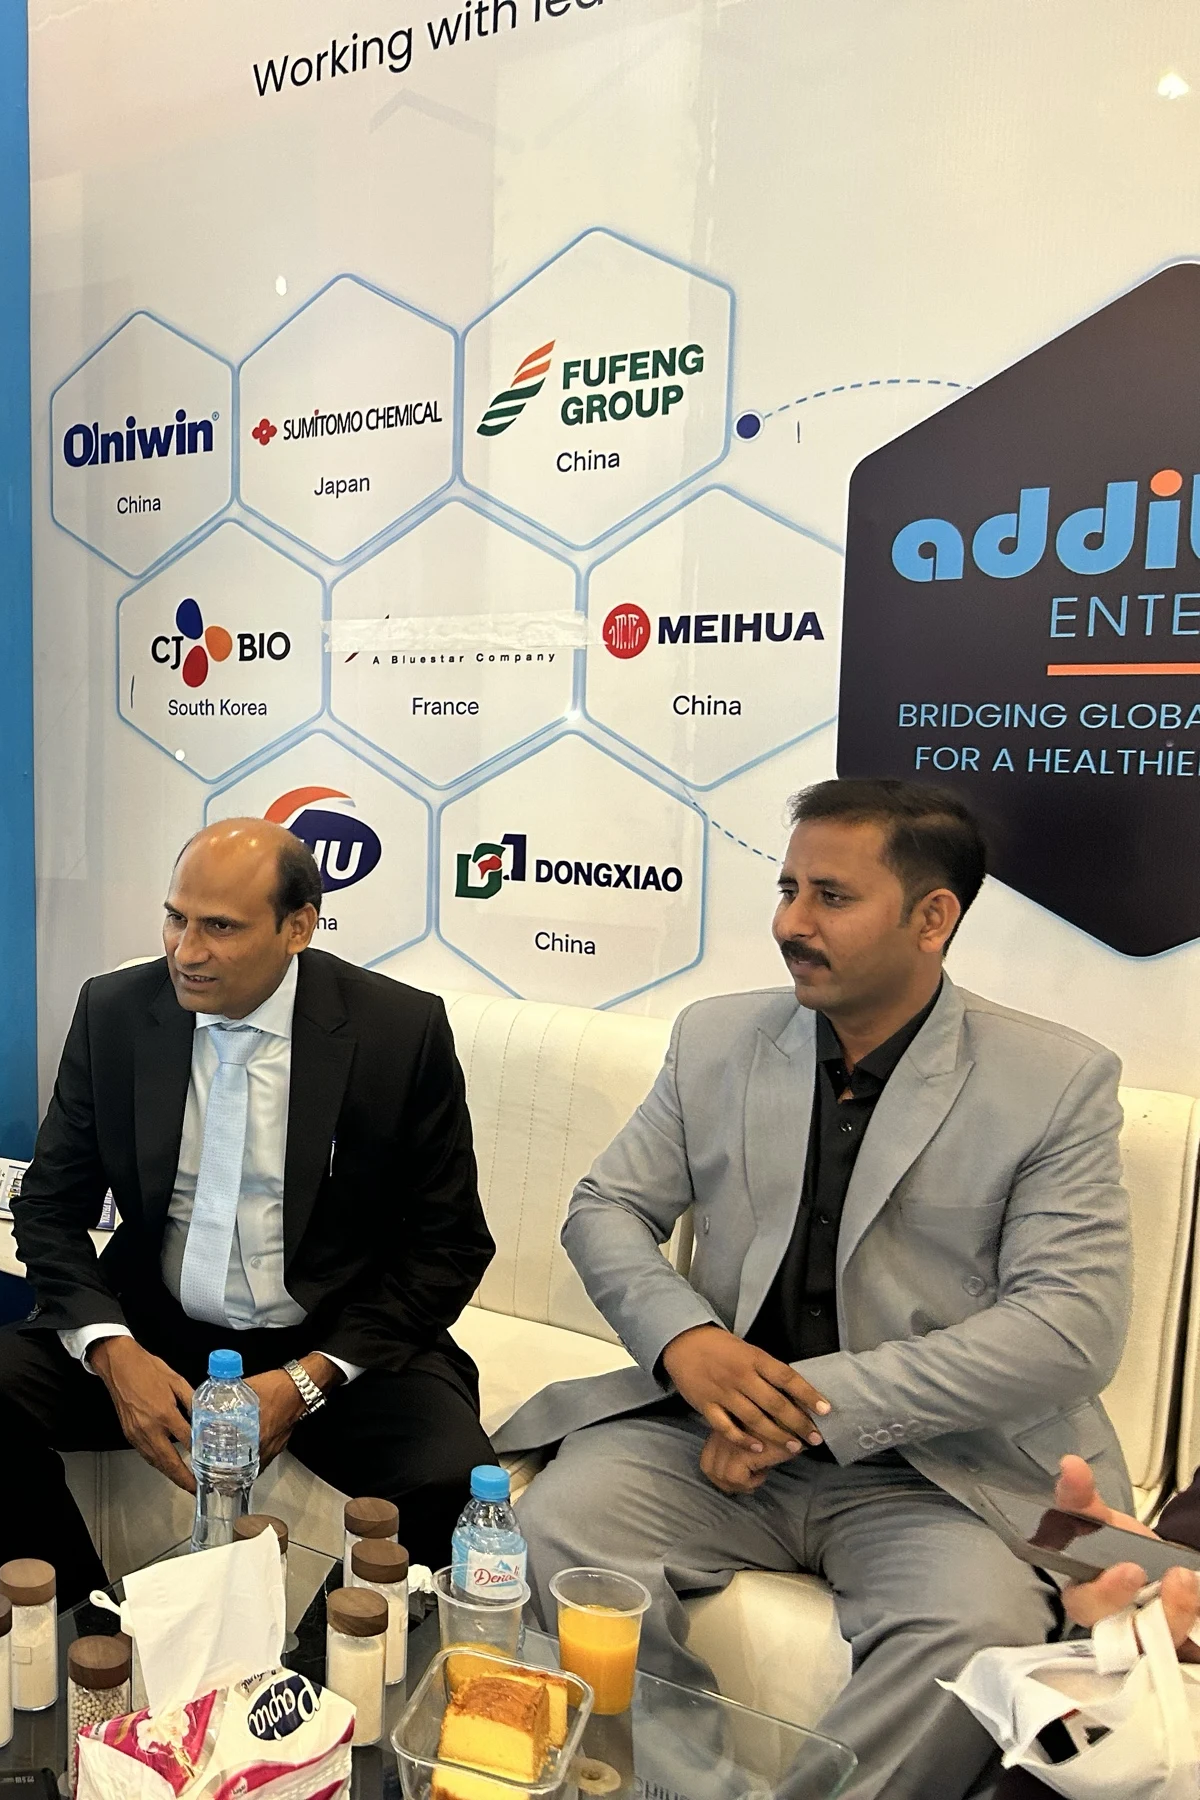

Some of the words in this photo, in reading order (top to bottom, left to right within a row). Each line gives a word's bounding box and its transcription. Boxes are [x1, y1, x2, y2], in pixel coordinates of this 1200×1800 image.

[253, 27, 412, 96] Working
[427, 0, 517, 50] with
[562, 344, 704, 390] FUFENG
[560, 384, 684, 426] GROUP
[283, 409, 363, 440] SUMITOMO
[366, 401, 442, 430] CHEMICAL
[556, 450, 620, 473] China
[314, 477, 370, 499] Japan
[117, 495, 161, 514] China
[657, 611, 825, 644] MEIHUA
[1050, 593, 1200, 638] ENTE
[151, 635, 184, 670] CJ
[237, 631, 291, 661] BIO
[372, 656, 380, 665] A
[391, 654, 465, 665] Bluestar
[476, 653, 555, 663] Company
[168, 698, 214, 716] South
[220, 699, 267, 716] Korea
[412, 697, 479, 716] France
[673, 694, 742, 716] China
[898, 703, 1068, 728] BRIDGING
[1079, 703, 1200, 729] GLOBA
[915, 746, 980, 771] FOR
[992, 748, 1014, 772] A
[1027, 748, 1200, 776] HEALTHIE
[535, 859, 683, 892] DONGXIAO
[534, 931, 596, 955] China
[248, 1674, 320, 1742] Papia
